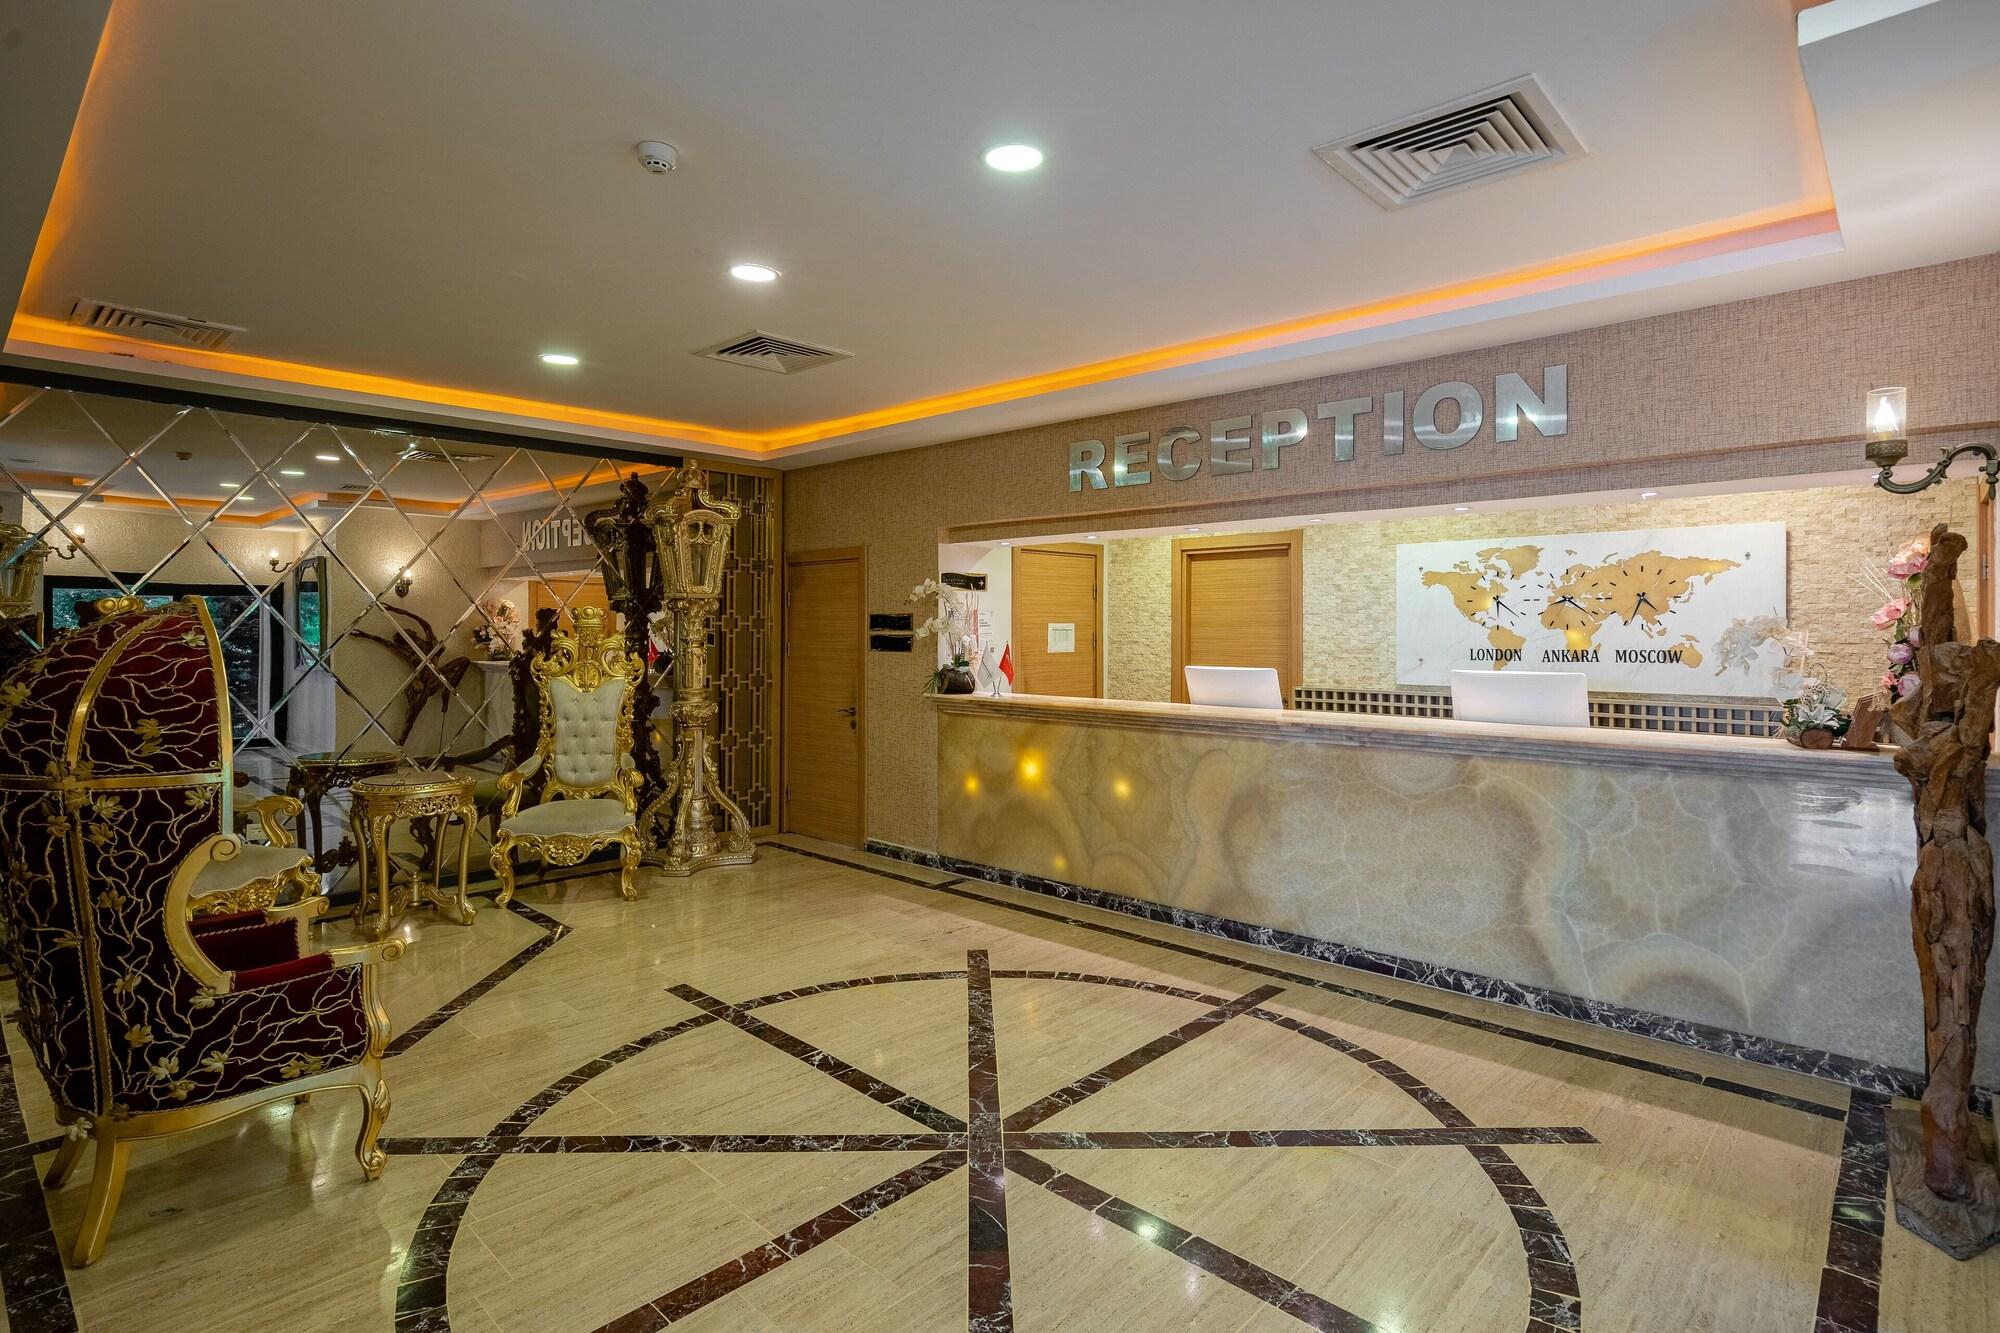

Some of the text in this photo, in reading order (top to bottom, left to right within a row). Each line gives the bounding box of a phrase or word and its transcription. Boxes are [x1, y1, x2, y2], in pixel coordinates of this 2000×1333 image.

[1069, 364, 1568, 492] RECEPTION
[1469, 648, 1683, 664] LONDON ANKARA MOSCOW
